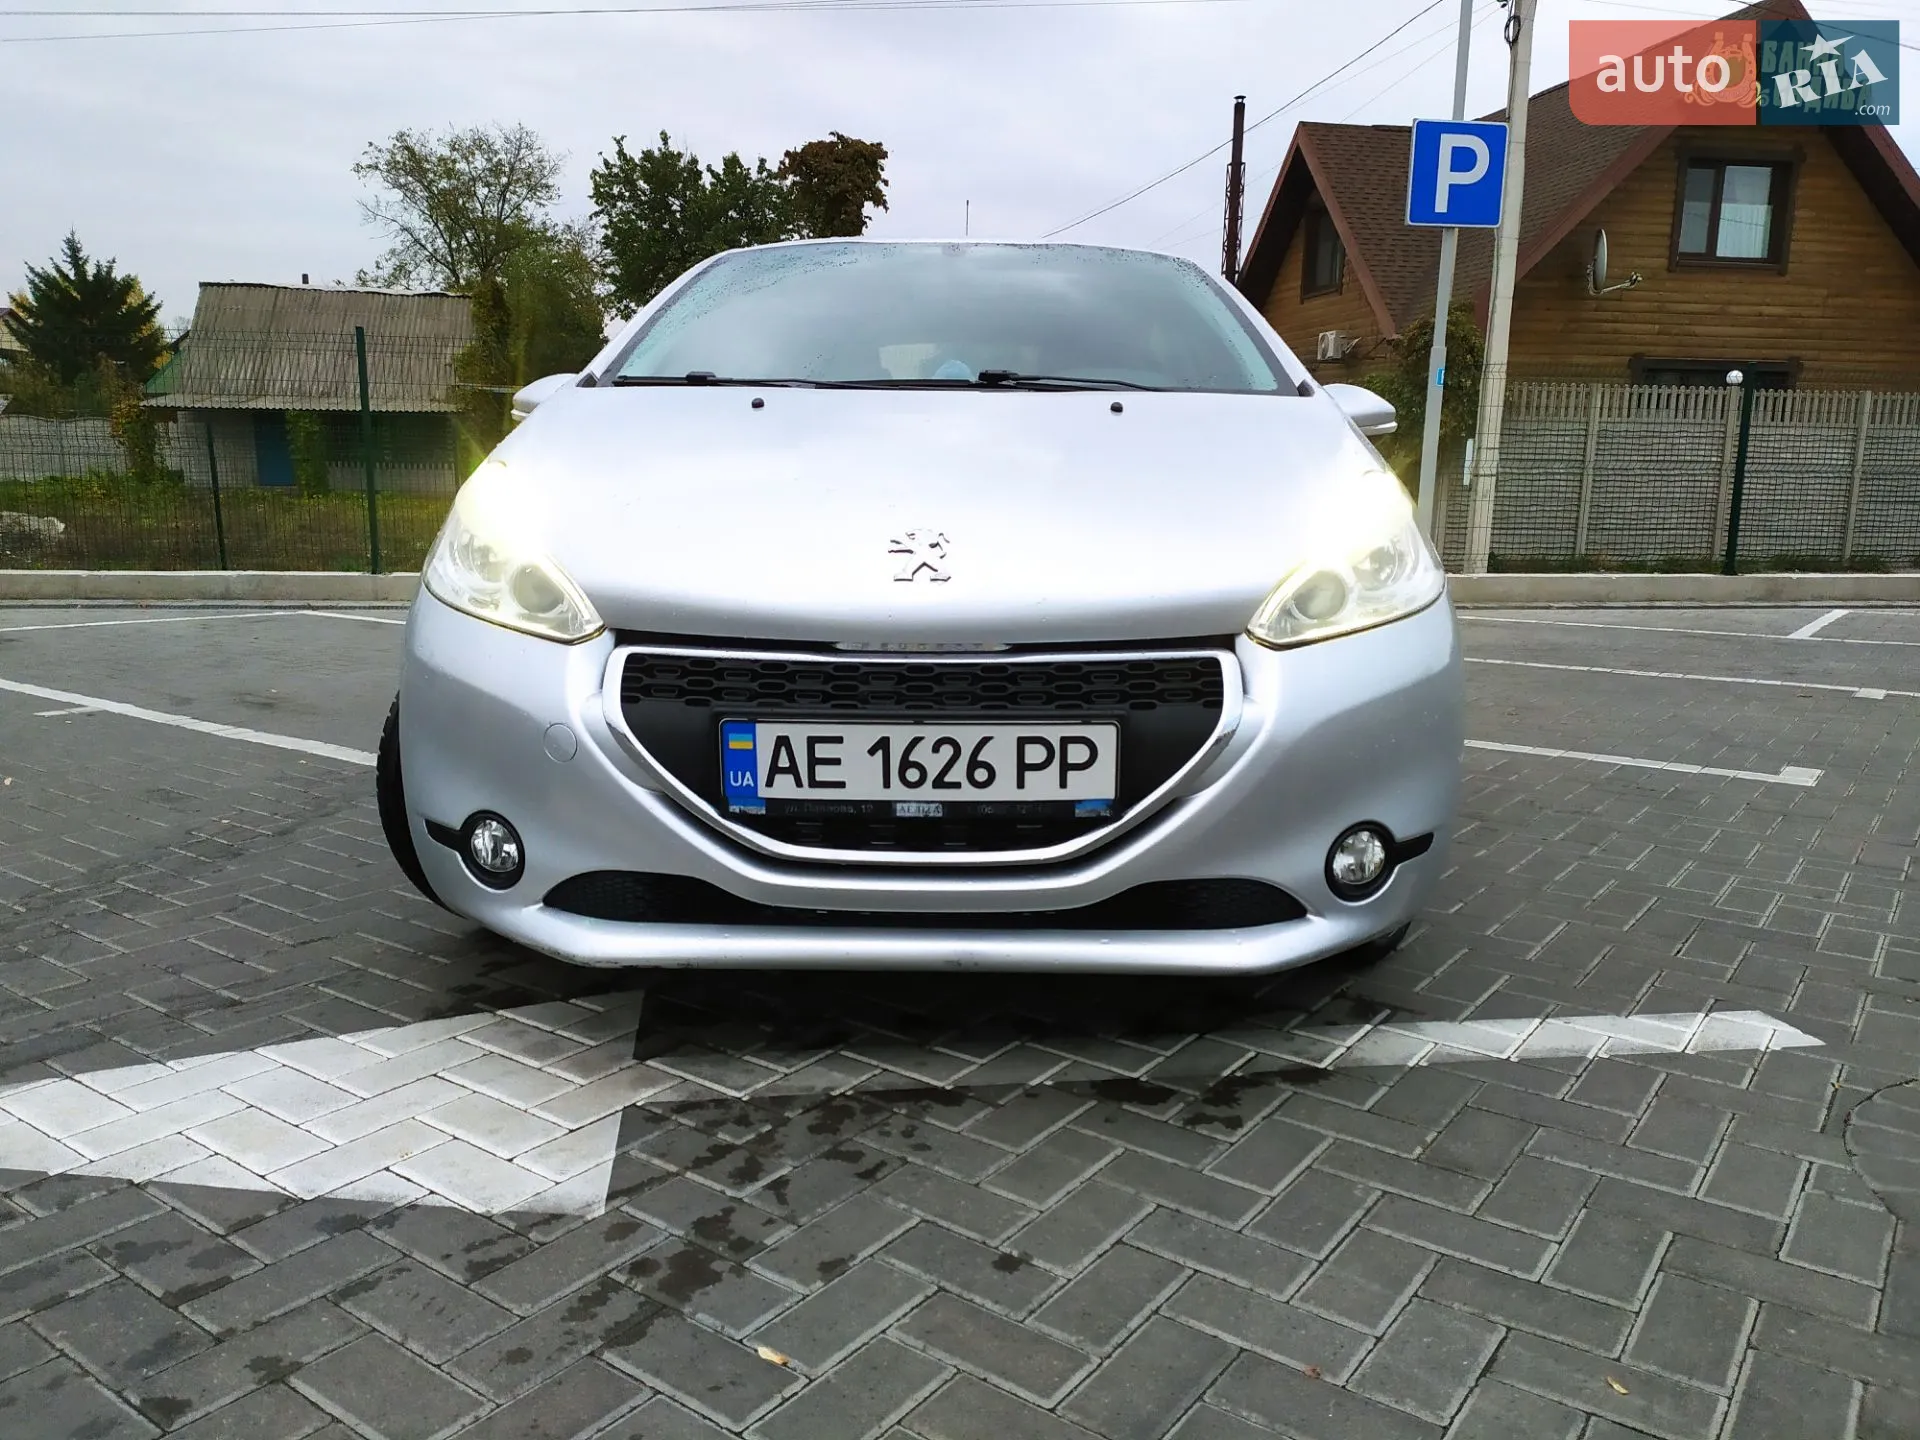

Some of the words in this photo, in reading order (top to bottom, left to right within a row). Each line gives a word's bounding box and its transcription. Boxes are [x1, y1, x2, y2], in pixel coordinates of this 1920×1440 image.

[1434, 133, 1490, 213] P
[730, 771, 754, 787] UA
[764, 735, 847, 789] AE
[867, 735, 997, 790] 1626
[1016, 735, 1099, 790] PP
